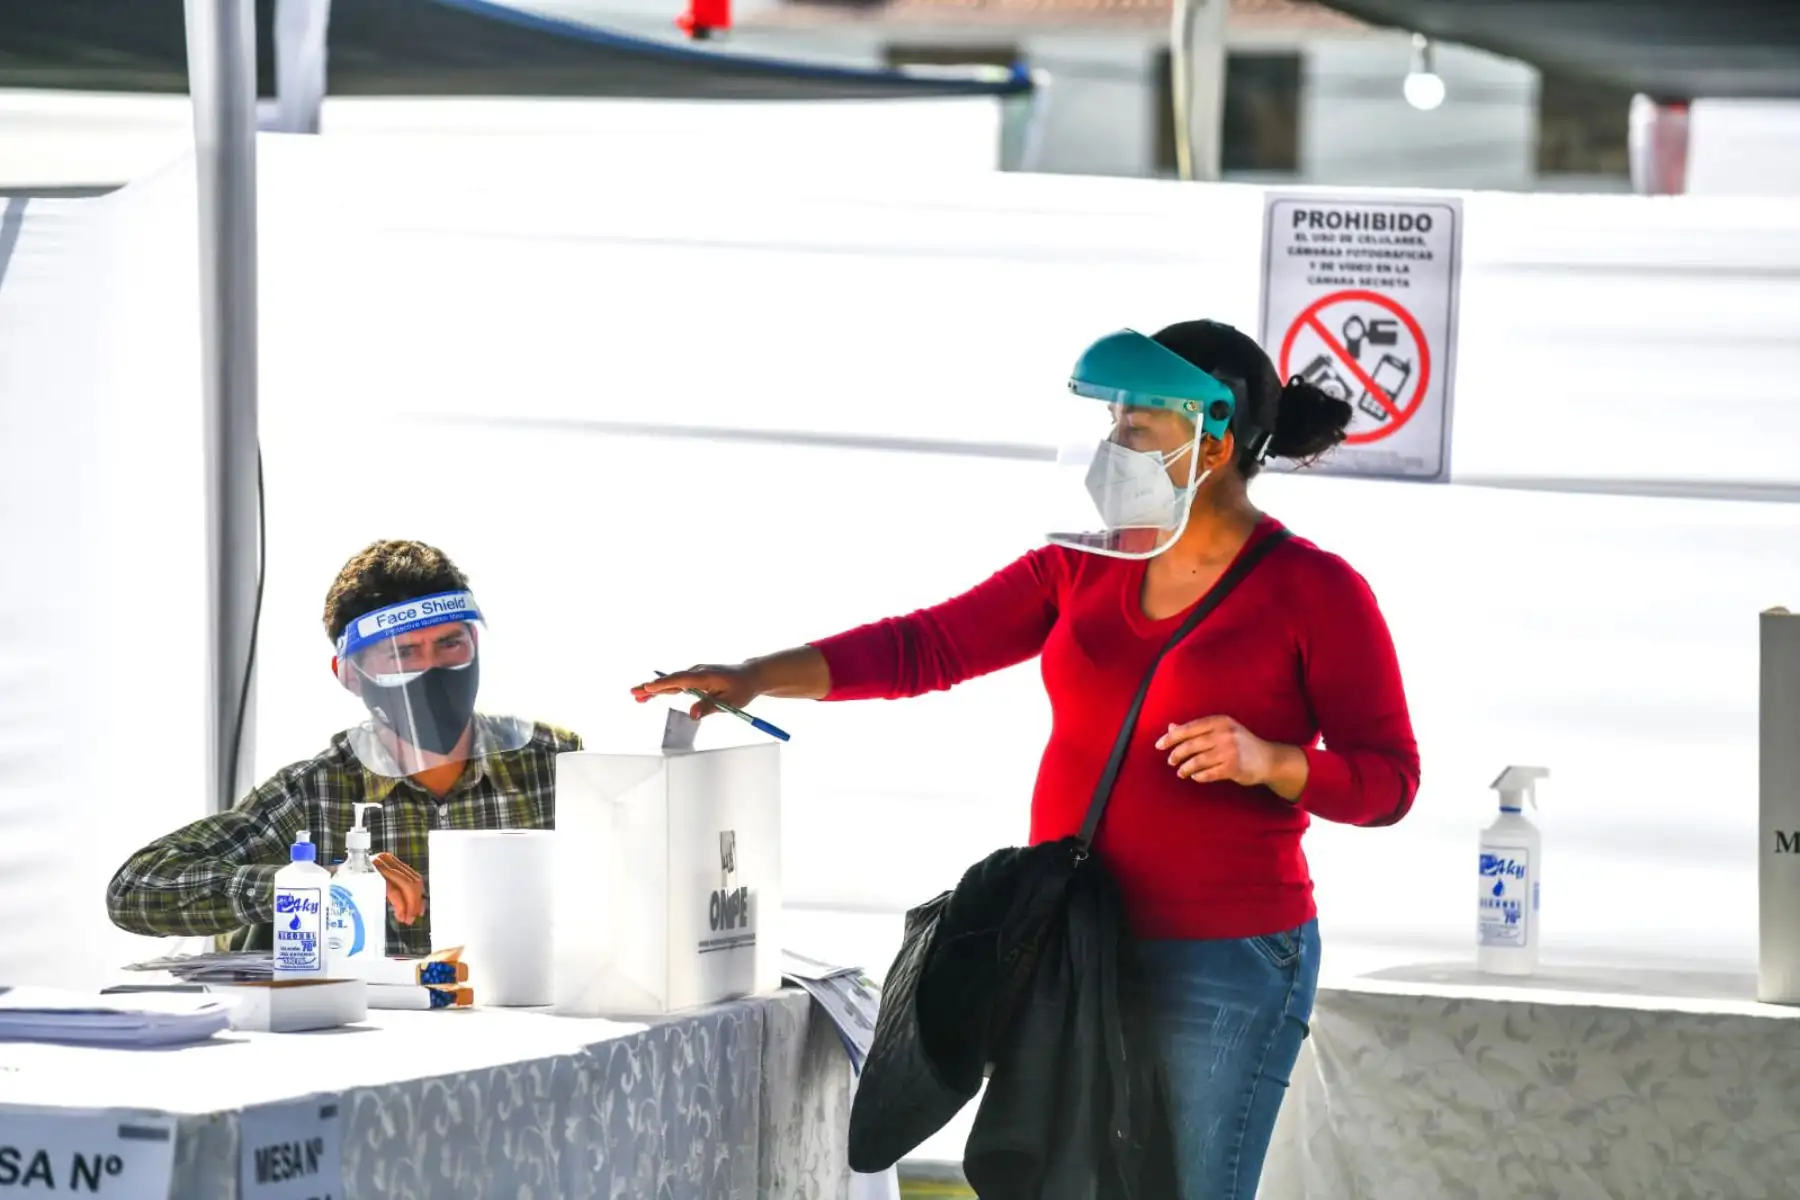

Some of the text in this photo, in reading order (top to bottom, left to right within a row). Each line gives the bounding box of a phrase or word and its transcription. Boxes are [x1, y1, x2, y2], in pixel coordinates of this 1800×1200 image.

[1292, 209, 1433, 233] PROHIBIDO
[376, 608, 417, 628] Face
[421, 596, 466, 615] Shield
[710, 886, 749, 931] ONPE
[254, 1140, 306, 1186] MESA
